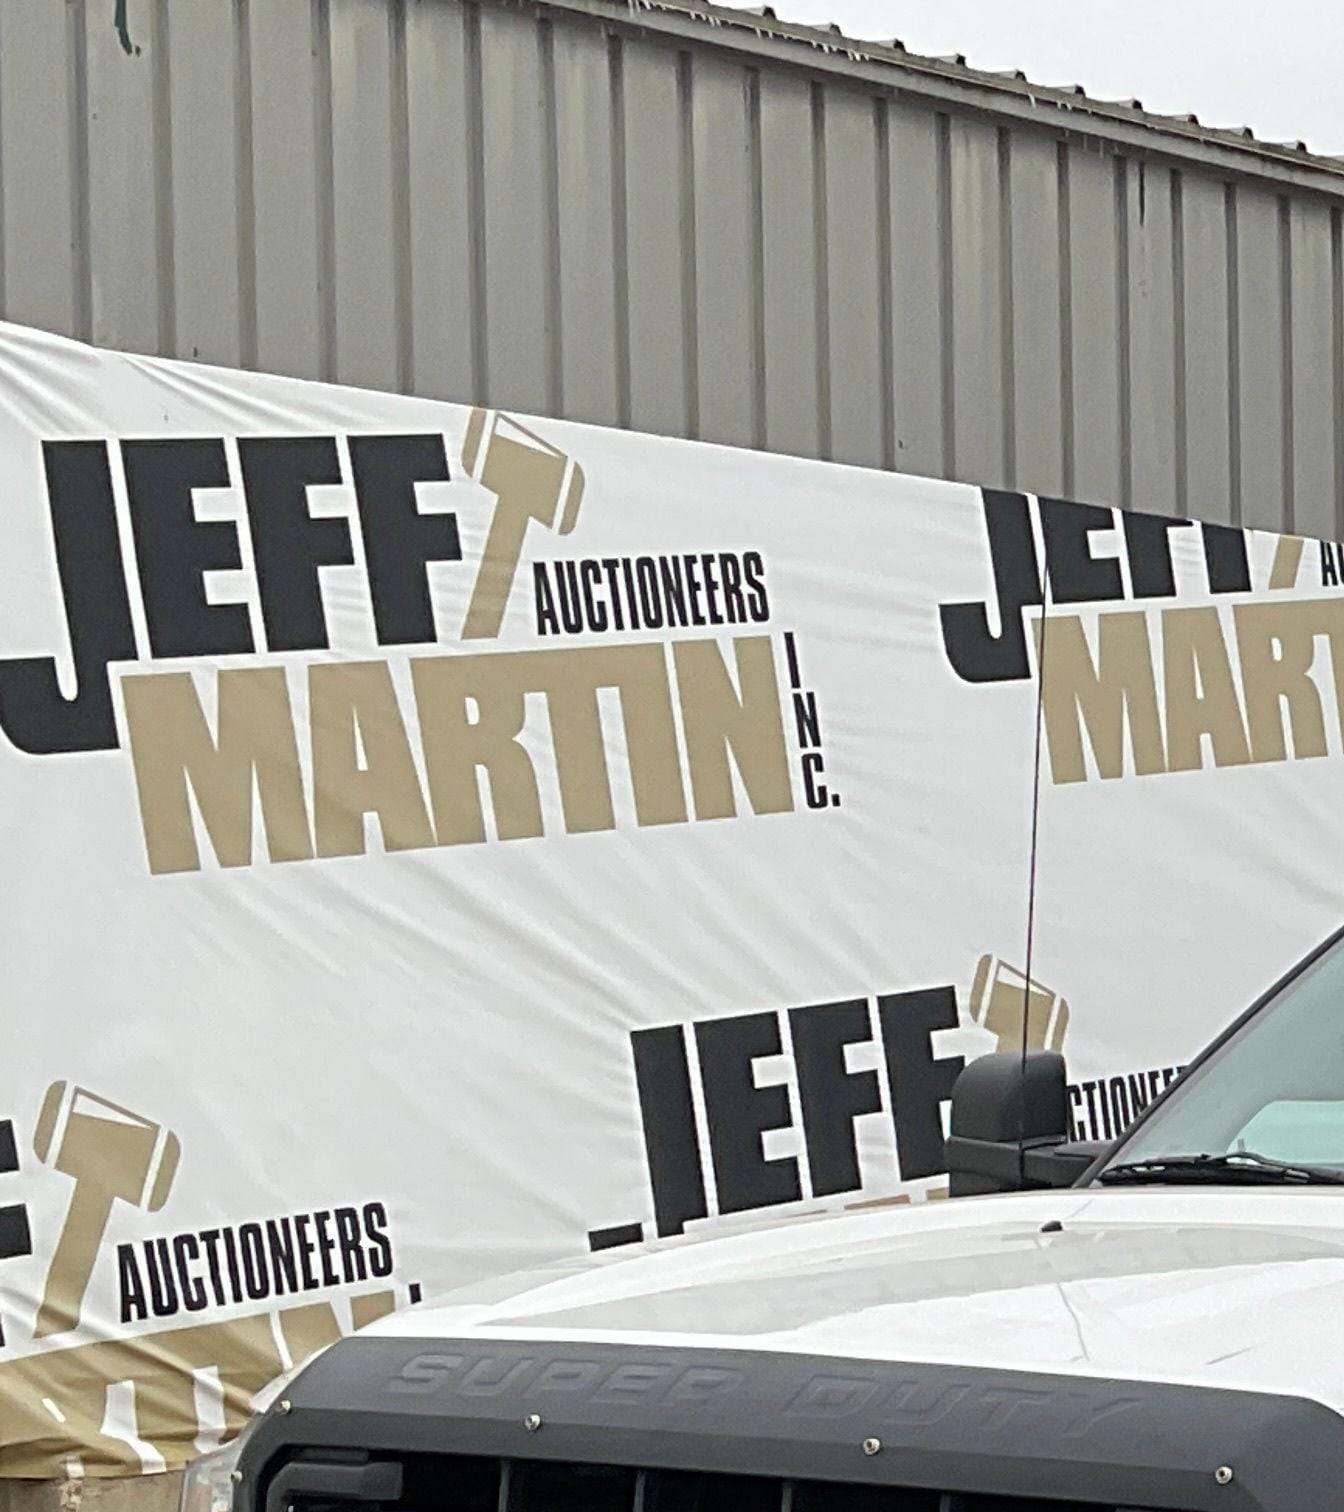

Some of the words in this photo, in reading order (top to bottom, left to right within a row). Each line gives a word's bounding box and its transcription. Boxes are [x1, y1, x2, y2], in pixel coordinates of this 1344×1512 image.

[0, 432, 462, 755] JEFF
[532, 551, 771, 635] AUCTIONEERS
[119, 636, 795, 875] MARTIN
[117, 1201, 394, 1324] AUCTIONEERS
[388, 1352, 748, 1404] SUPER
[783, 1373, 1131, 1438] DUTY
